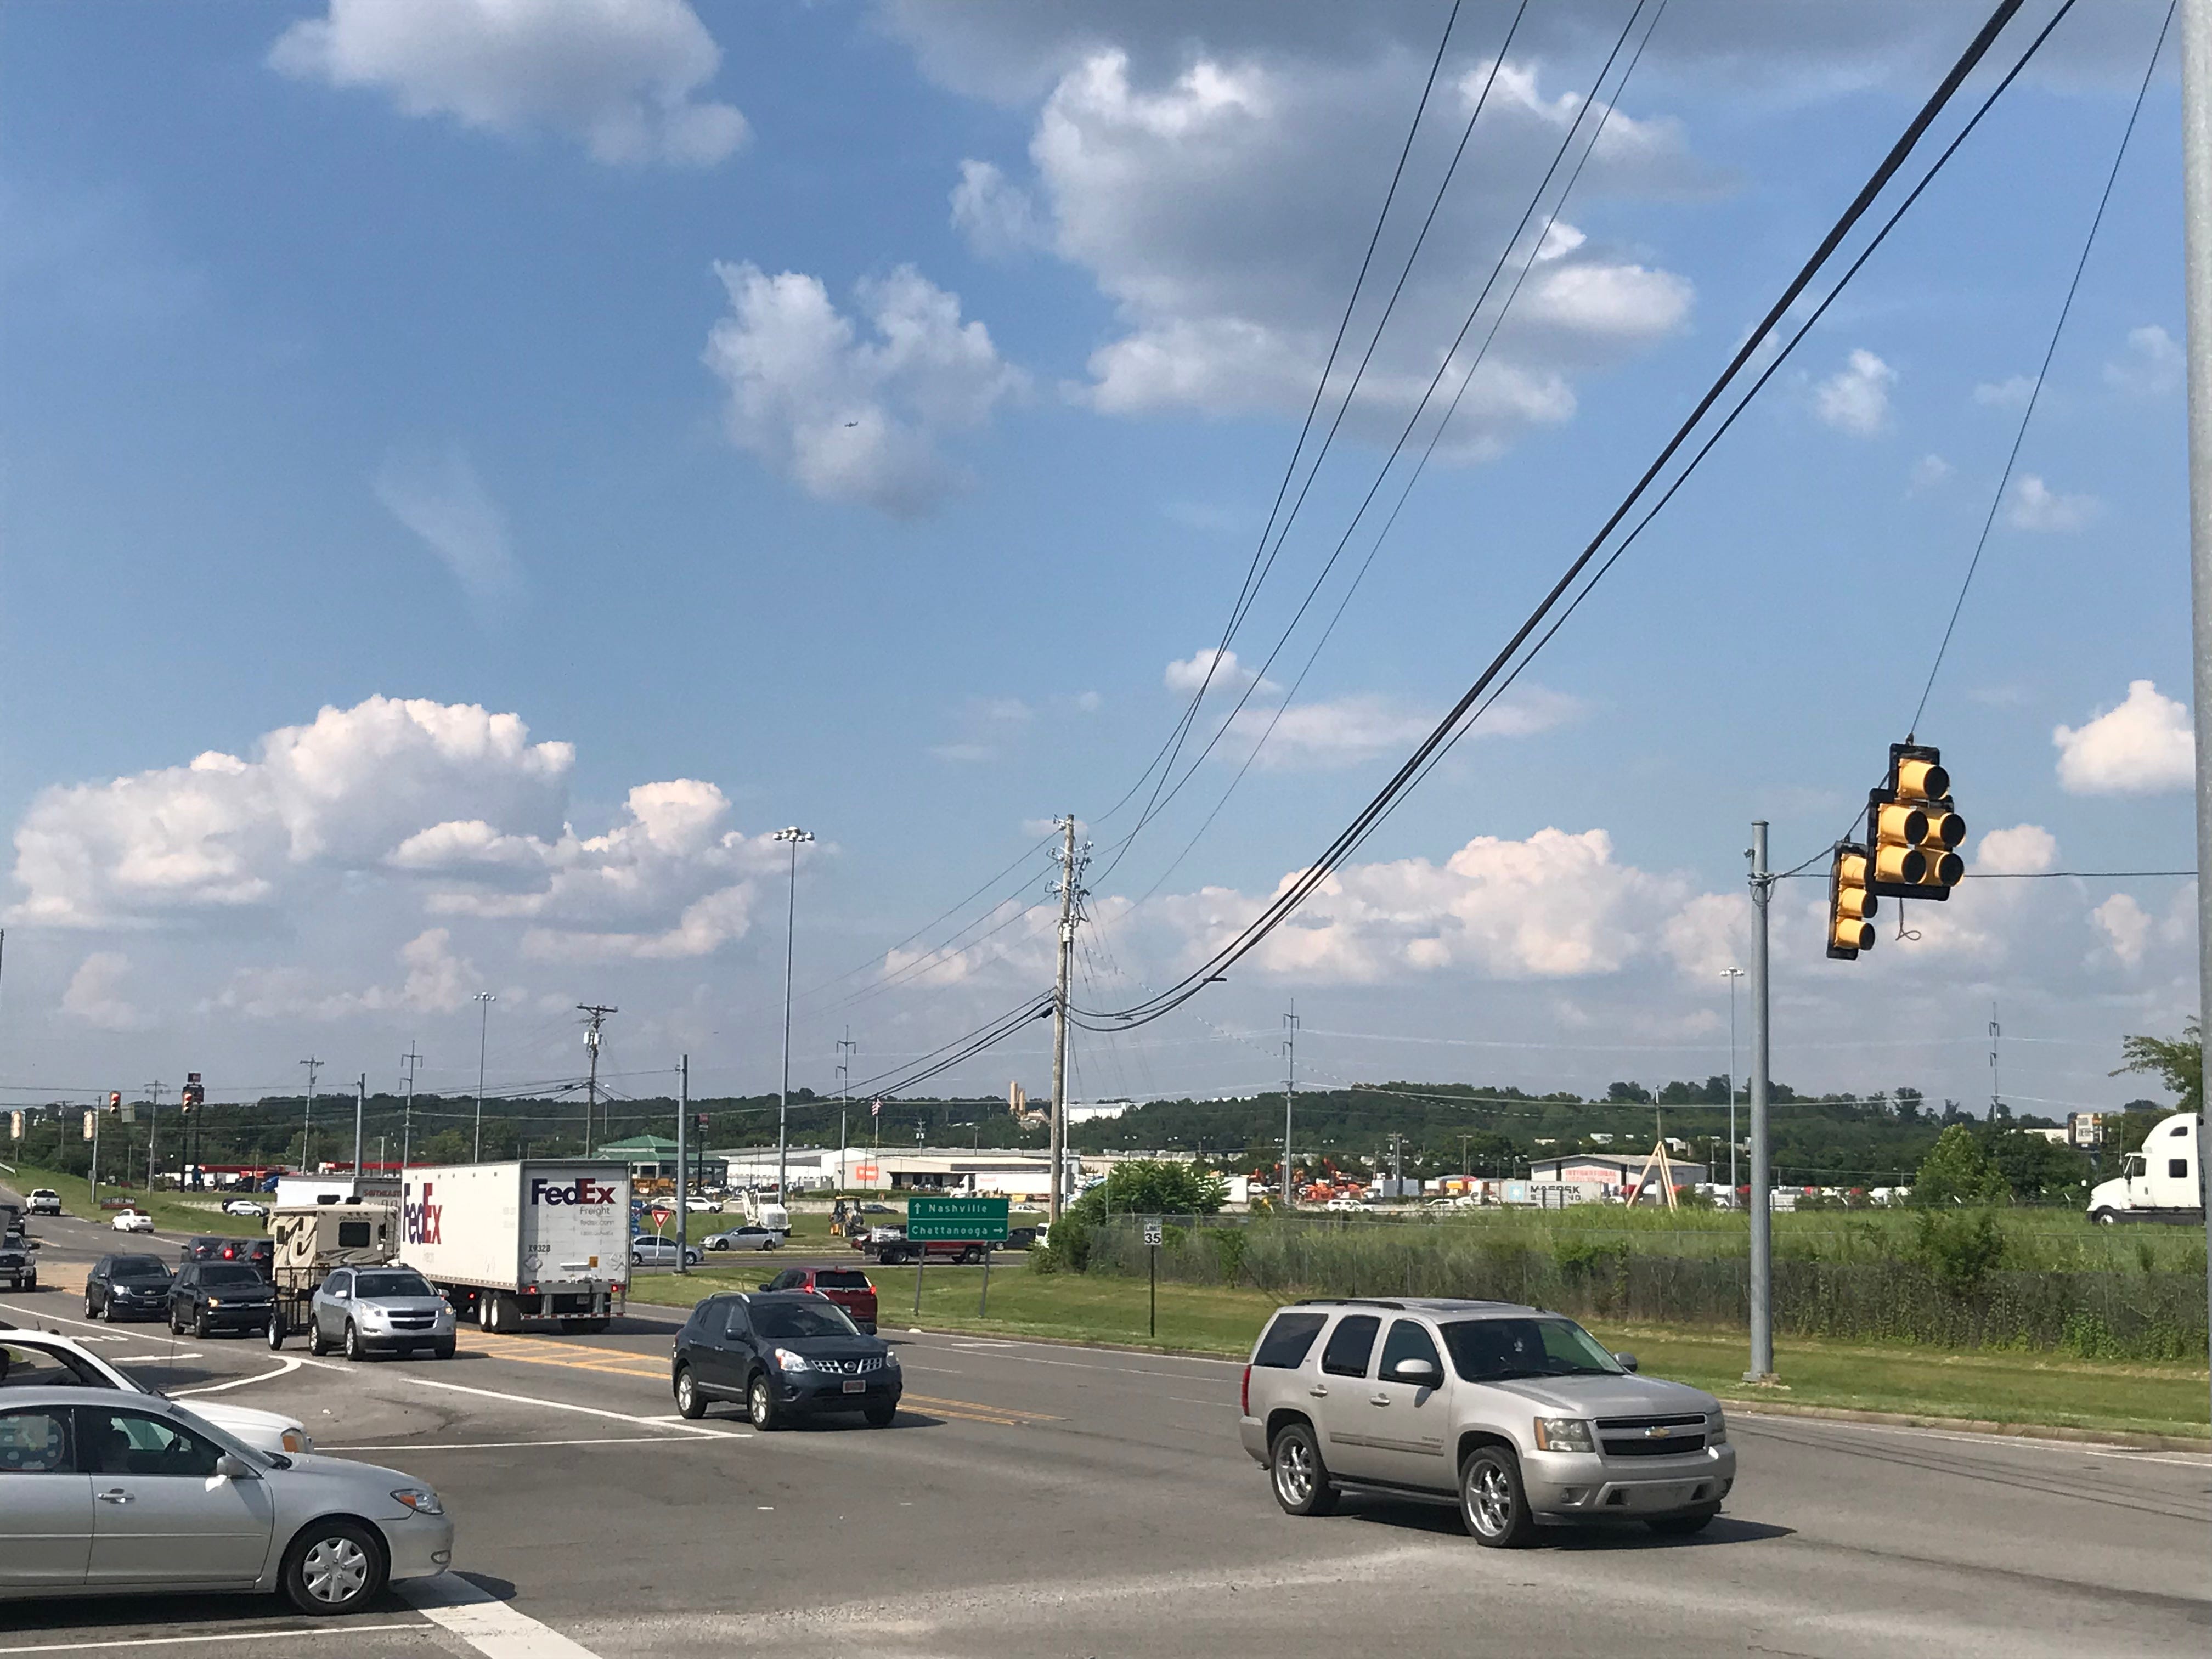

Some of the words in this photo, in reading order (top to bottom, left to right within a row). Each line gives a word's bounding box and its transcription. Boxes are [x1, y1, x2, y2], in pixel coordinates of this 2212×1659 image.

[531, 1178, 617, 1205] FedEx
[580, 1206, 610, 1218] Freight
[928, 1204, 988, 1212] Nashville
[403, 1183, 442, 1245] FedEx
[911, 1226, 988, 1237] Chattanooga
[1145, 1233, 1161, 1244] 35
